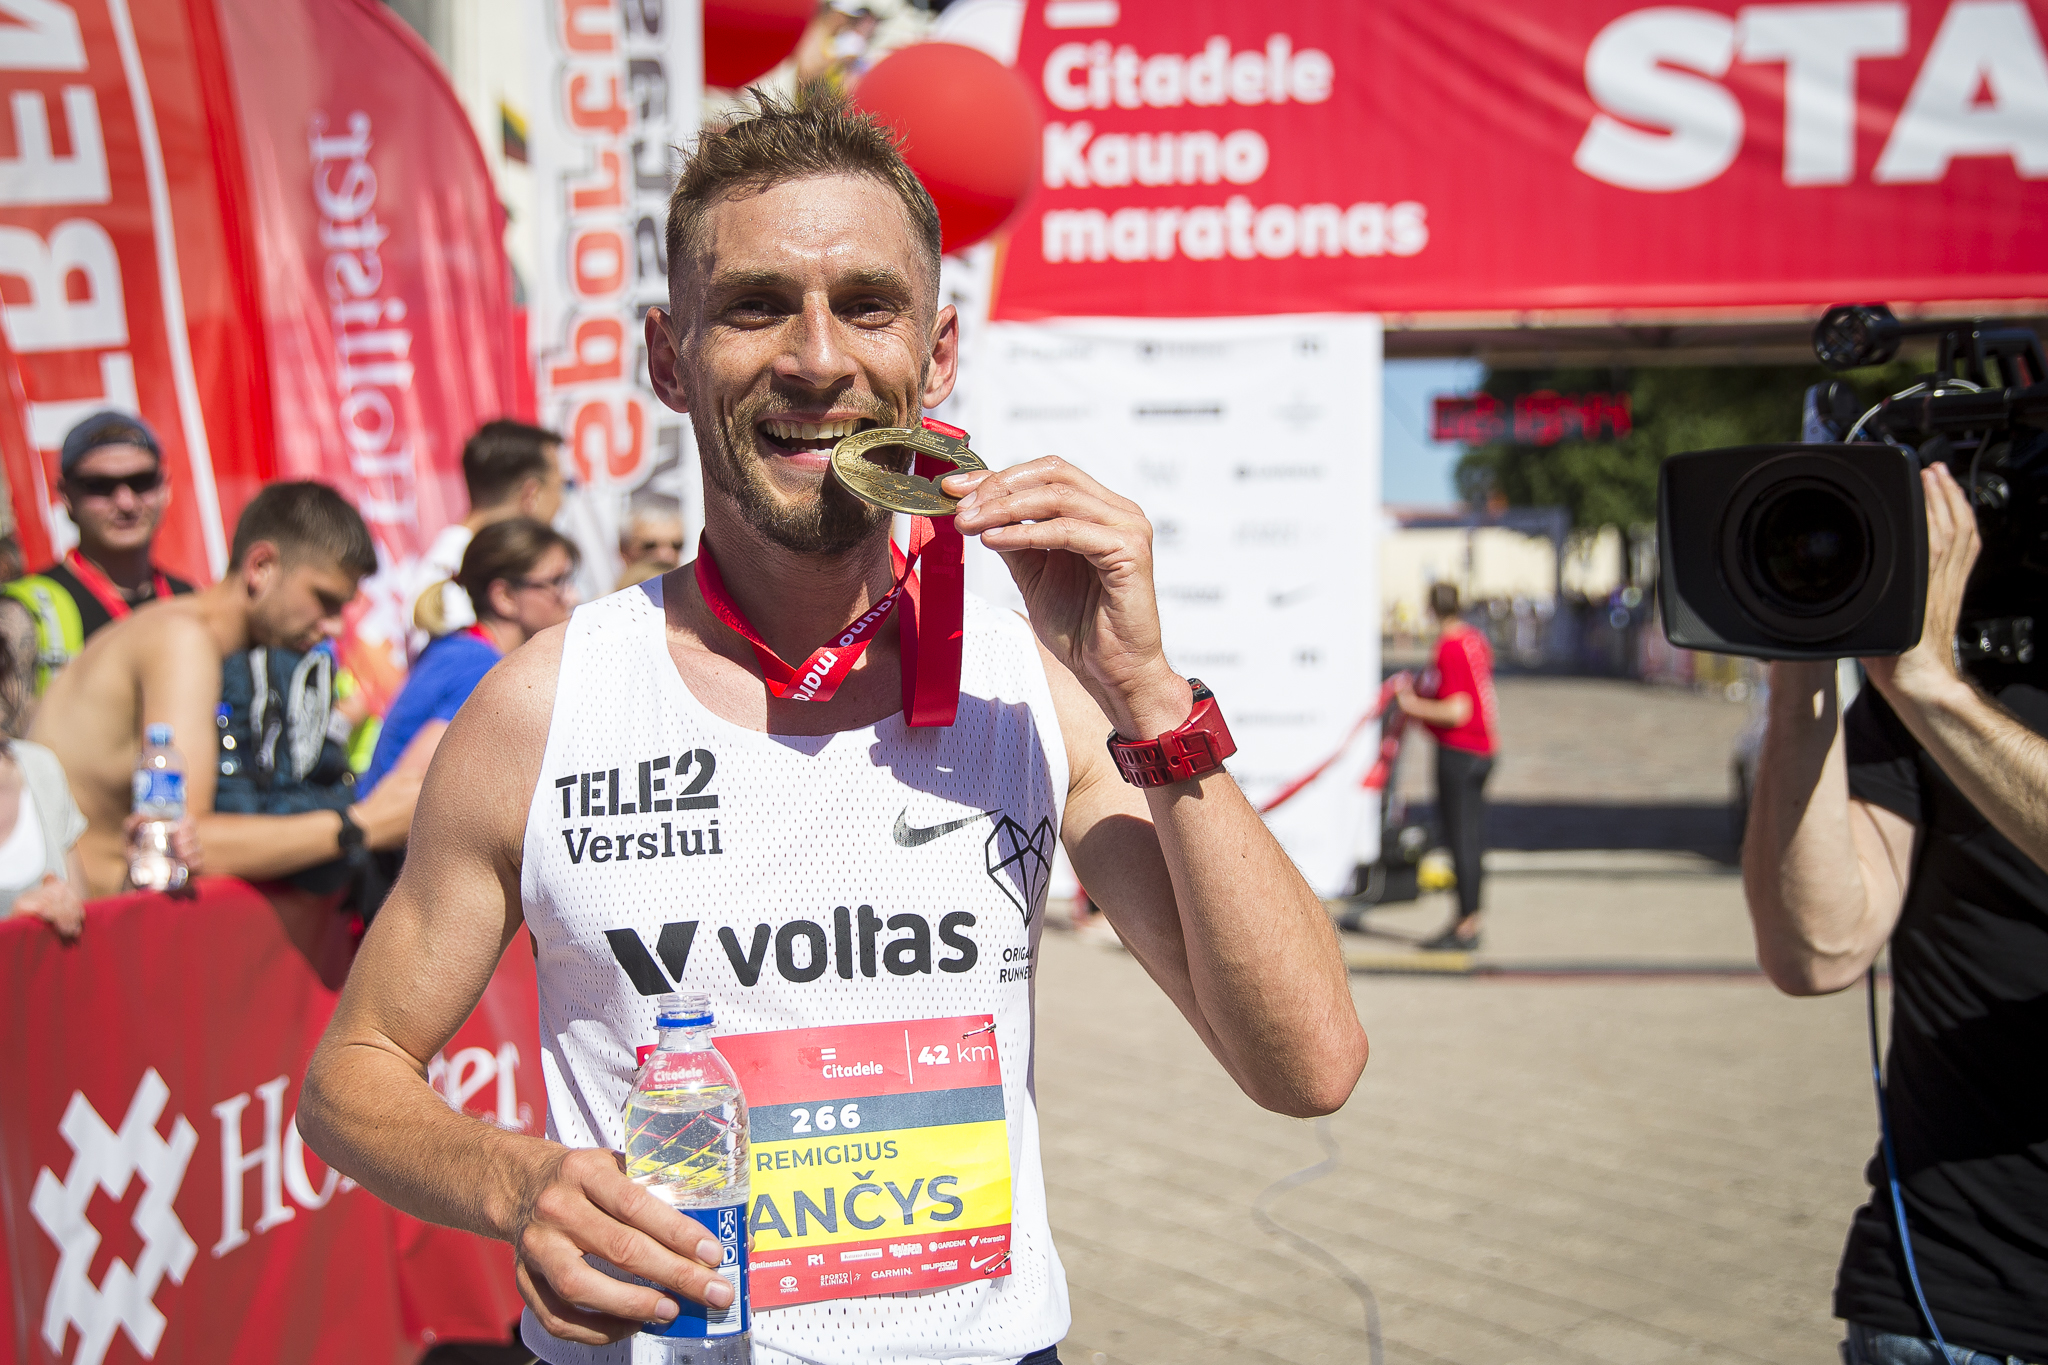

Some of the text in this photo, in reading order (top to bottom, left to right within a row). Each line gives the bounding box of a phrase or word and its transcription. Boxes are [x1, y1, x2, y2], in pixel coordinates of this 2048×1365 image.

[1044, 34, 1333, 111] Citadele
[1574, 0, 2048, 192] STA
[1044, 121, 1267, 188] Kauno
[1044, 195, 1428, 262] maratonas
[555, 748, 719, 819] TELE2
[562, 821, 723, 864] Verslui
[717, 904, 978, 987] voltas
[822, 1060, 884, 1080] Citadele
[918, 1042, 995, 1066] 42 km
[653, 1067, 703, 1083] Citadele
[789, 1103, 861, 1134] 266
[756, 1140, 899, 1172] REMIGIJUS
[937, 1240, 966, 1249] GARDENA
[820, 1272, 849, 1282] SPORTO
[820, 1279, 849, 1287] KLINIKA
